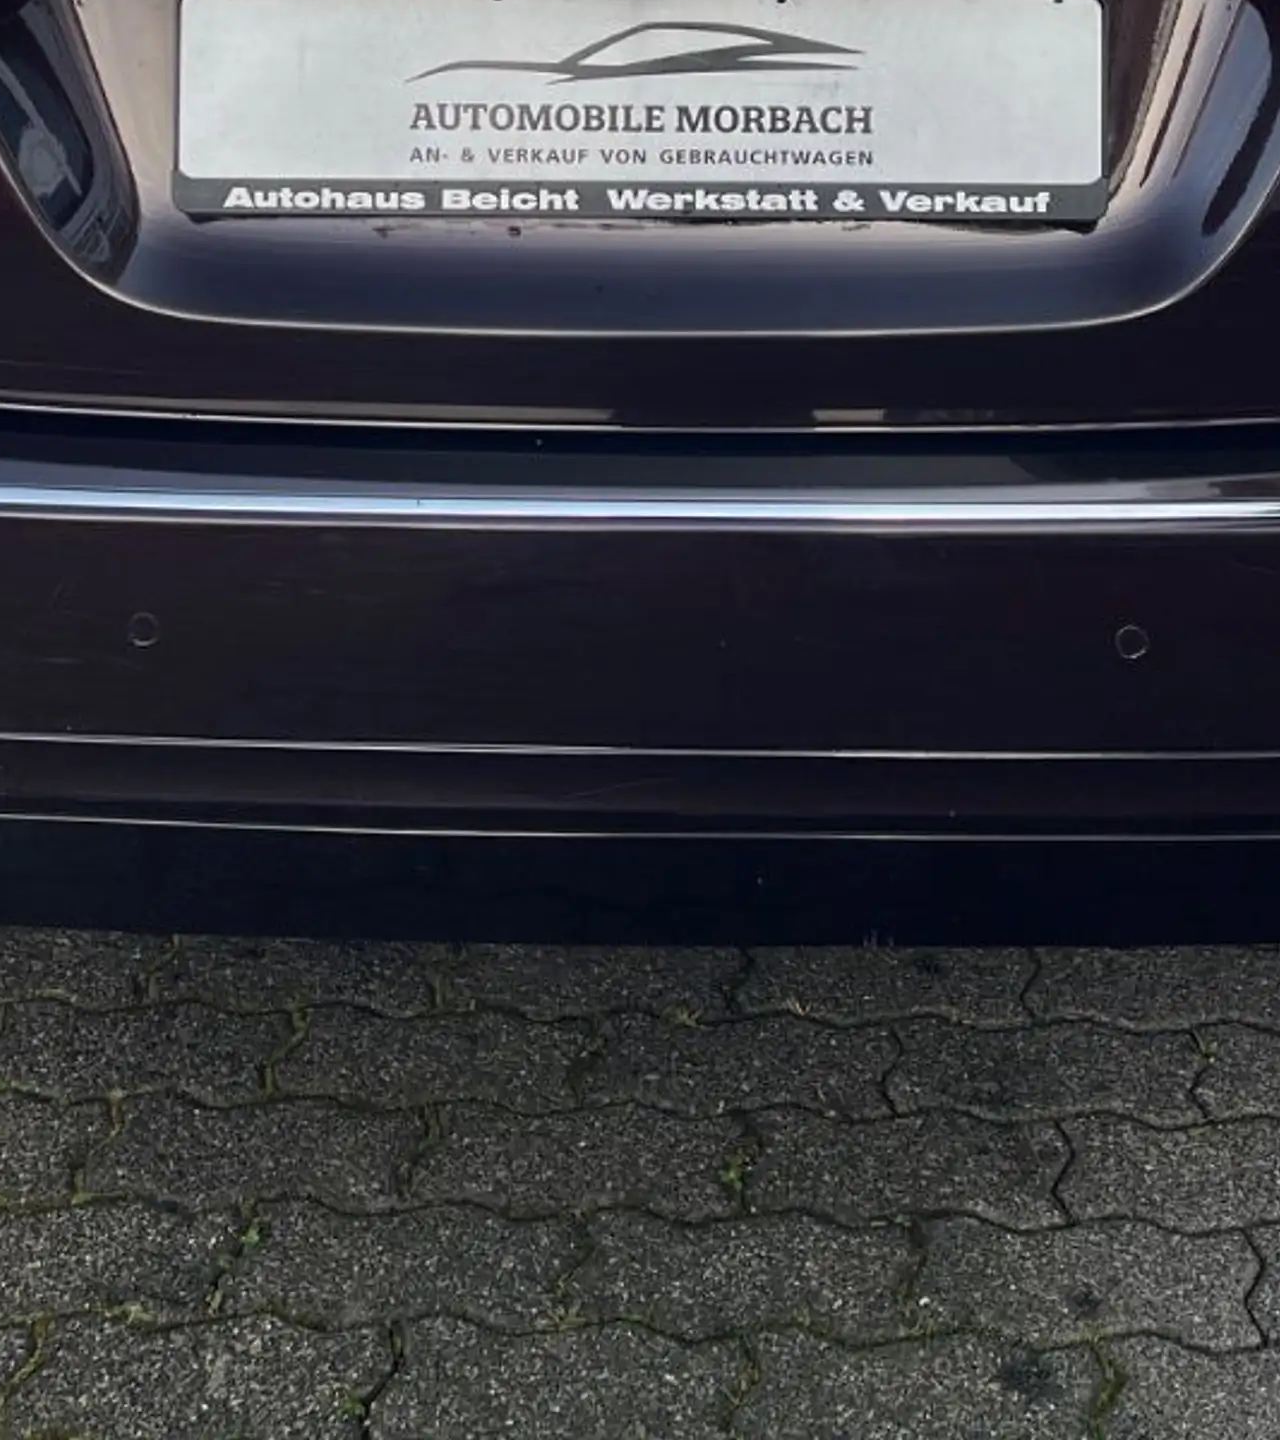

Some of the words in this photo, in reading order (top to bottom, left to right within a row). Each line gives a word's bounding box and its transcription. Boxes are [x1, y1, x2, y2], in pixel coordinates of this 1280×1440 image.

[410, 103, 665, 133] AUTOMOBILE
[675, 106, 873, 134] MORBACH
[409, 147, 449, 163] AN-
[461, 147, 475, 163] &
[488, 147, 589, 164] VERKAUF
[601, 148, 647, 165] VON
[660, 149, 874, 167] GEBRAUCHTWAGEN
[223, 187, 425, 209] Autohaus
[441, 188, 580, 211] Beicht
[607, 188, 818, 212] Werkstatt
[833, 190, 865, 212] &
[880, 191, 1050, 213] Verkauf
